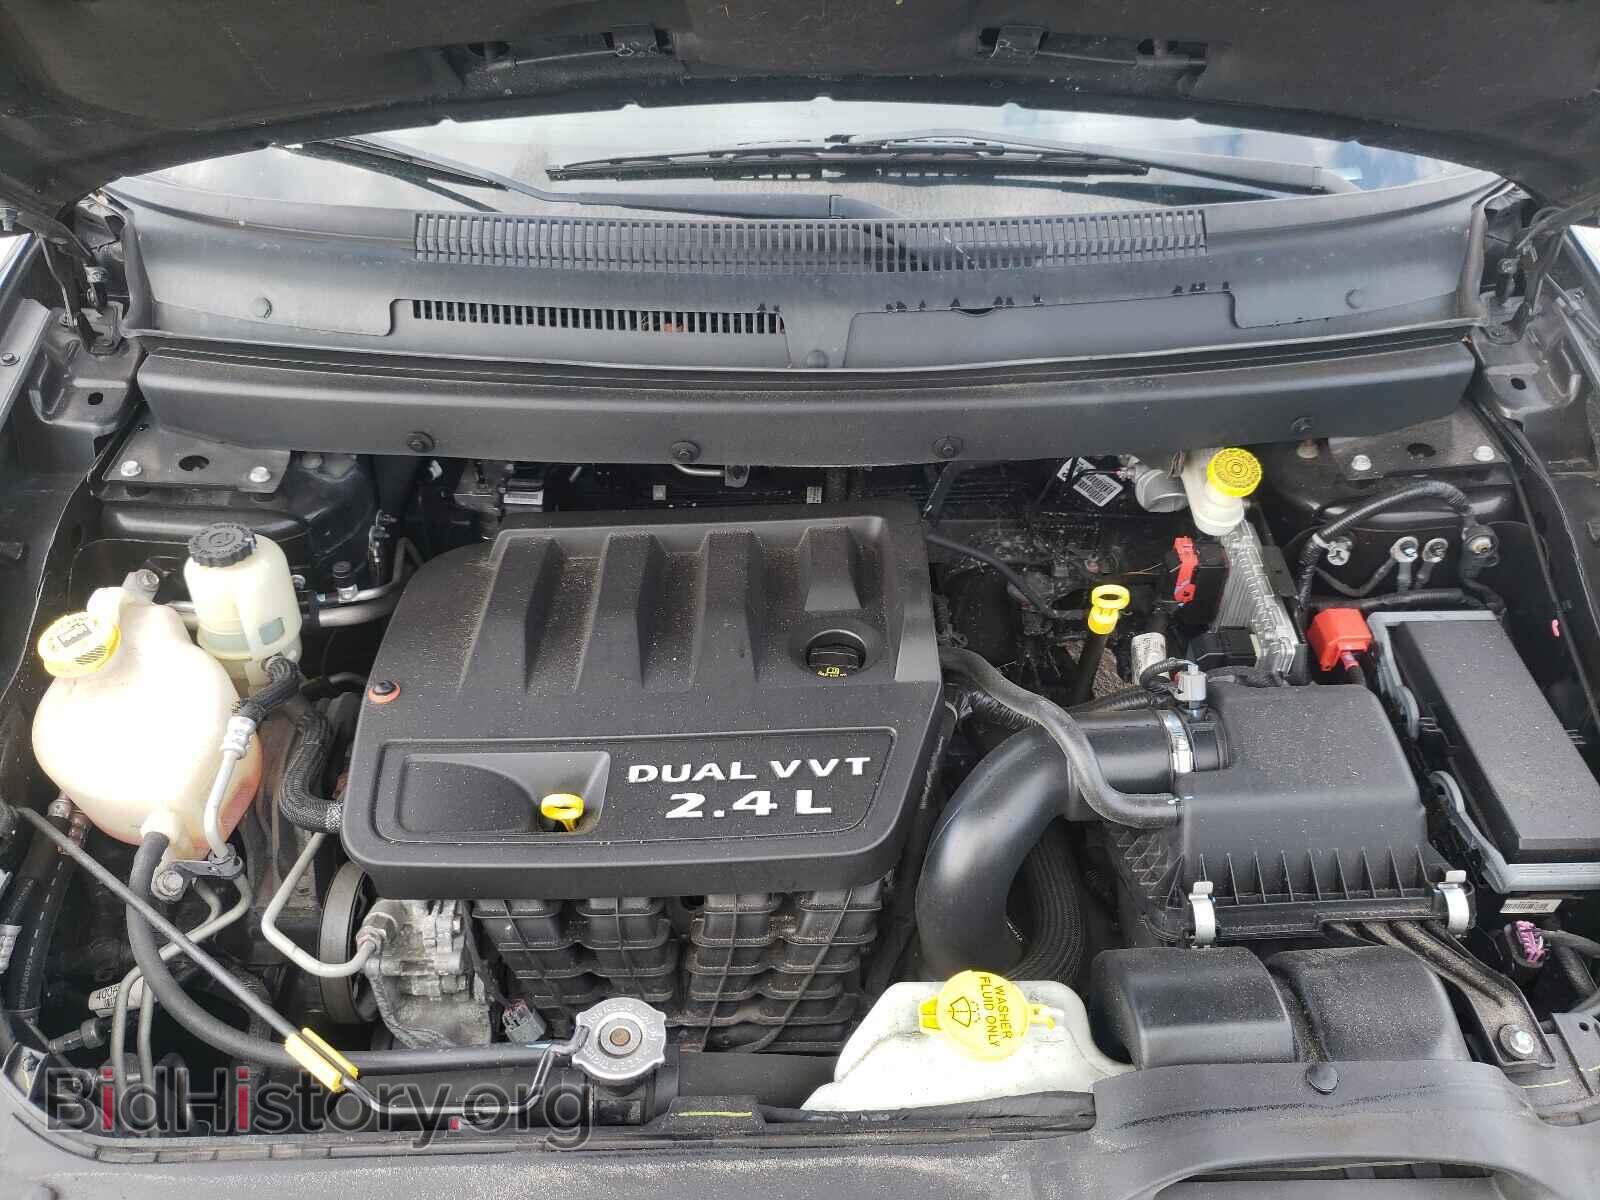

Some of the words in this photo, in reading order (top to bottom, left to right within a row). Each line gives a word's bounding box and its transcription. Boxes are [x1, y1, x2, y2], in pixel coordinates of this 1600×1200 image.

[627, 761, 757, 784] DUAL
[769, 756, 871, 779] VVT
[665, 790, 778, 820] 2.4
[795, 789, 832, 816] L
[980, 976, 995, 1012] FLUID
[994, 985, 1014, 1040] WASHER
[985, 1014, 1001, 1048] ONLY
